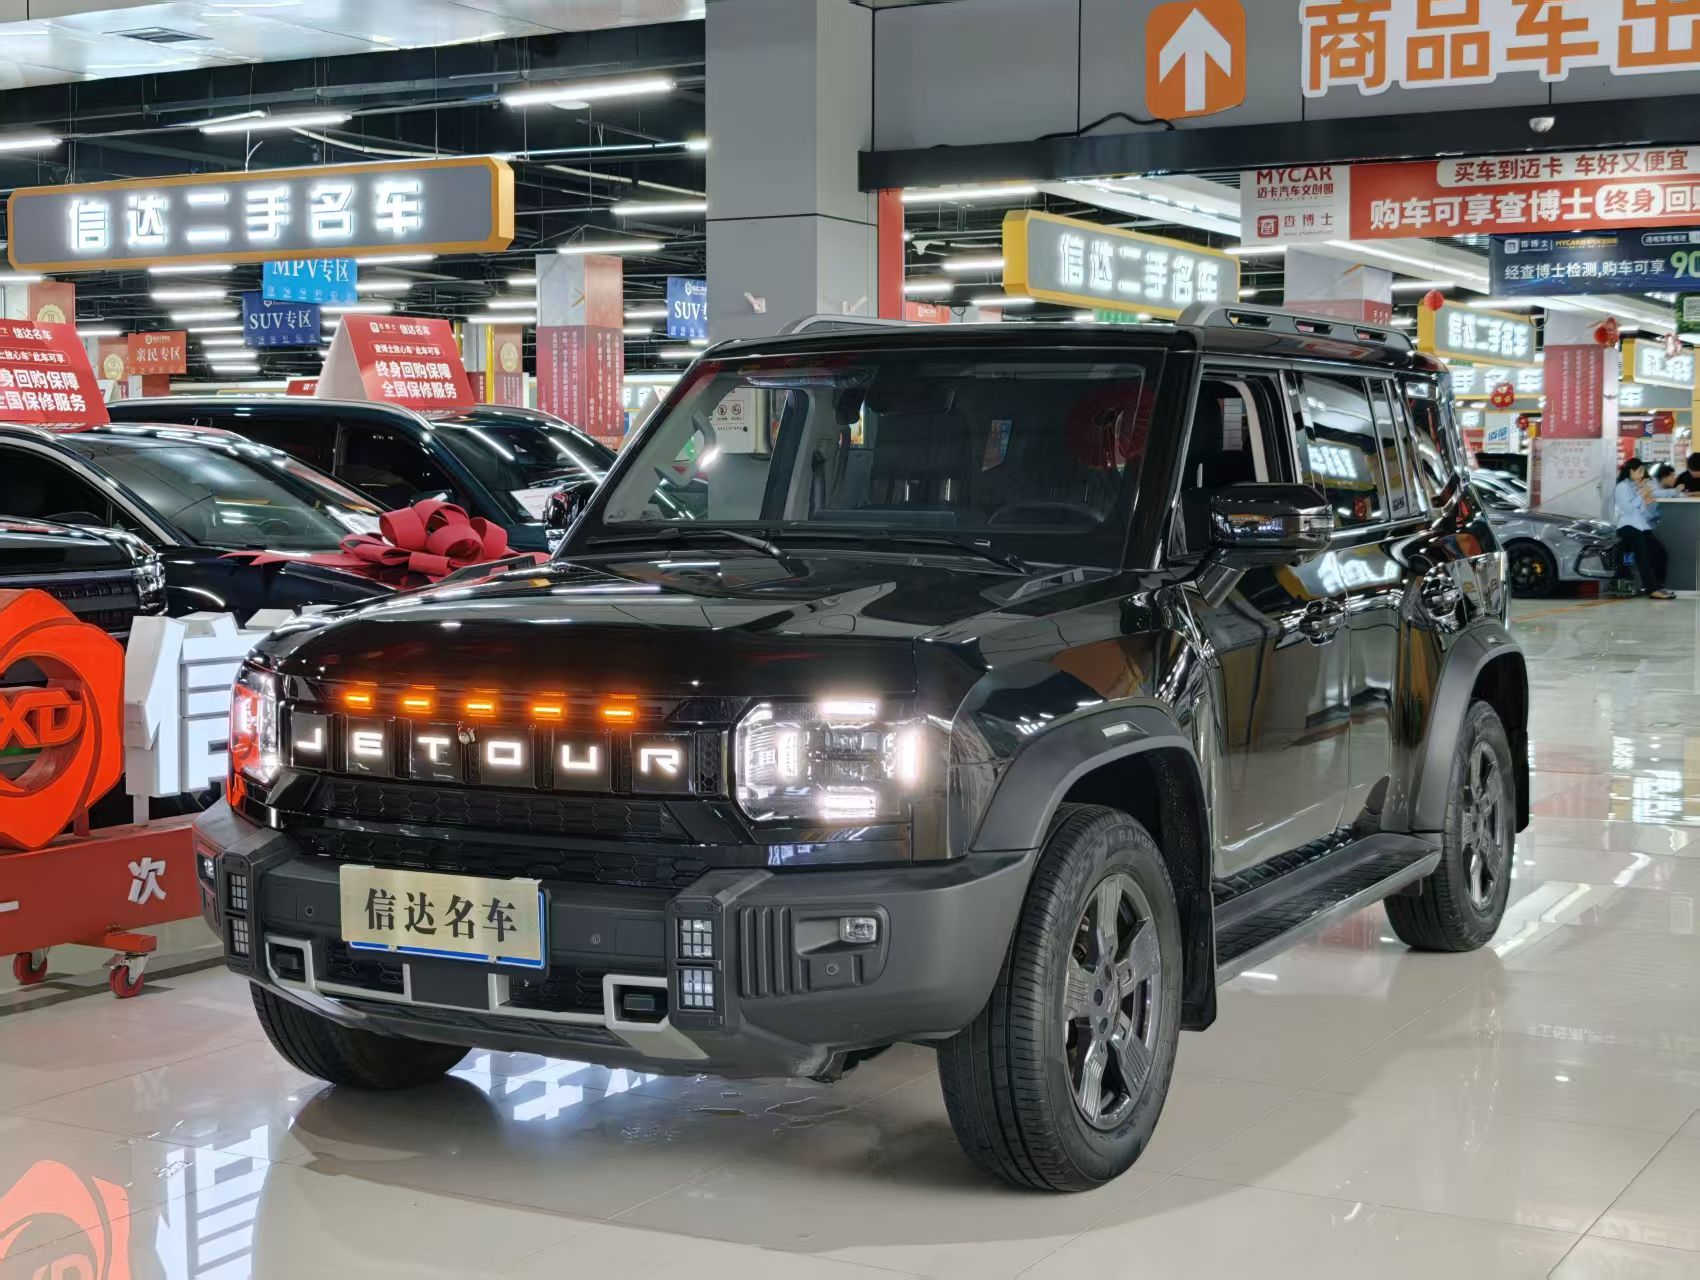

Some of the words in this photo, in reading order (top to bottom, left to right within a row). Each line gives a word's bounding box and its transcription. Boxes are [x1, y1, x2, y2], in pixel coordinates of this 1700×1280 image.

[1256, 167, 1333, 185] MYCAR
[1454, 156, 1563, 183] 买车到迈卡
[1574, 149, 1689, 176] 车好又便宜
[69, 178, 424, 251] 信达二手名车
[272, 258, 349, 282] MPV专区
[1059, 233, 1219, 303] 信达二手名车
[249, 309, 312, 330] SUV专区
[137, 345, 181, 363] 亲民专区
[375, 360, 452, 380] 终身回购保障
[382, 380, 457, 399] 全国保修服务
[296, 725, 681, 774] JETOUR
[127, 856, 167, 905] 次
[364, 887, 518, 943] 信达名车
